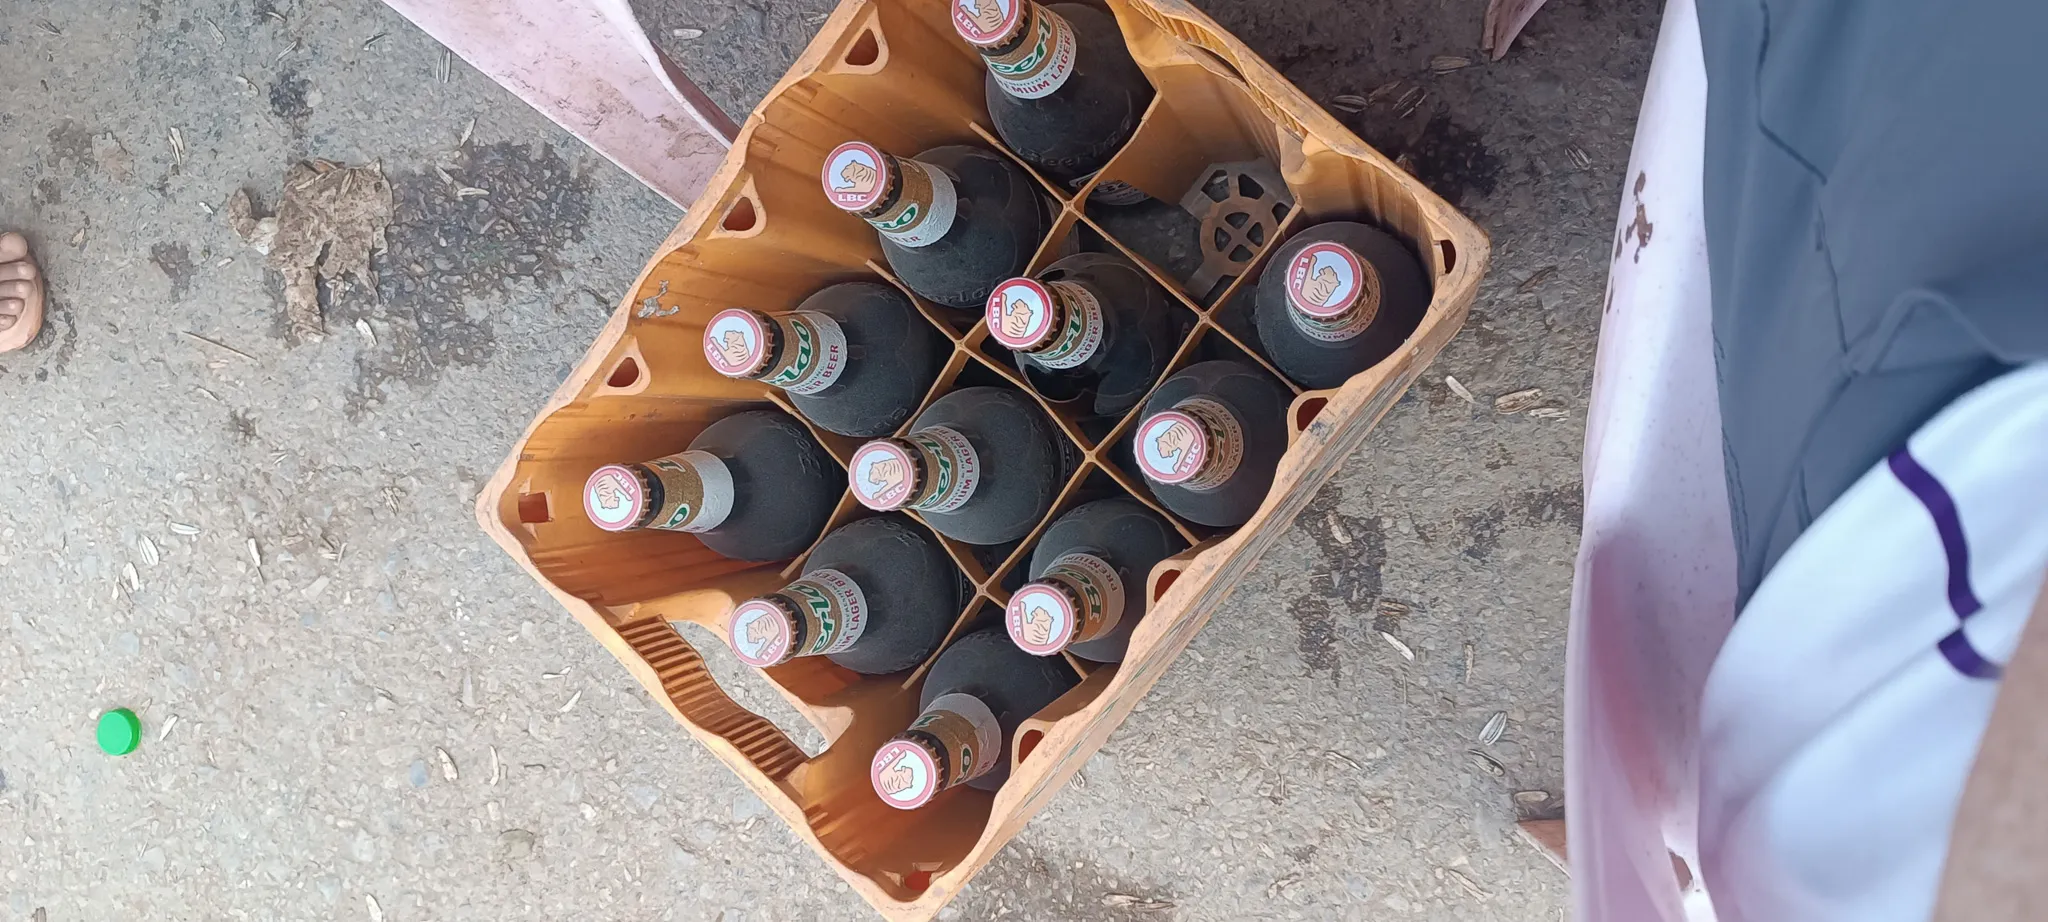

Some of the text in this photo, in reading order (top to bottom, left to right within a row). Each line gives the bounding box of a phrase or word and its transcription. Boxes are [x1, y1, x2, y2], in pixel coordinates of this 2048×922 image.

[956, 11, 981, 38] LBC
[1051, 36, 1071, 80] LAGER
[838, 193, 867, 202] LBC
[1293, 257, 1309, 290] LBC
[992, 297, 1000, 329] LBC
[707, 343, 729, 369] LBC
[823, 344, 839, 378] BEER
[951, 436, 974, 474] LAGER
[1180, 442, 1201, 474] LBC
[613, 470, 636, 495] LBC
[878, 483, 906, 505] LBC
[845, 588, 860, 631] LAGER
[1012, 605, 1022, 637] LBC
[761, 638, 784, 661] LBC
[876, 746, 901, 771] LBC
